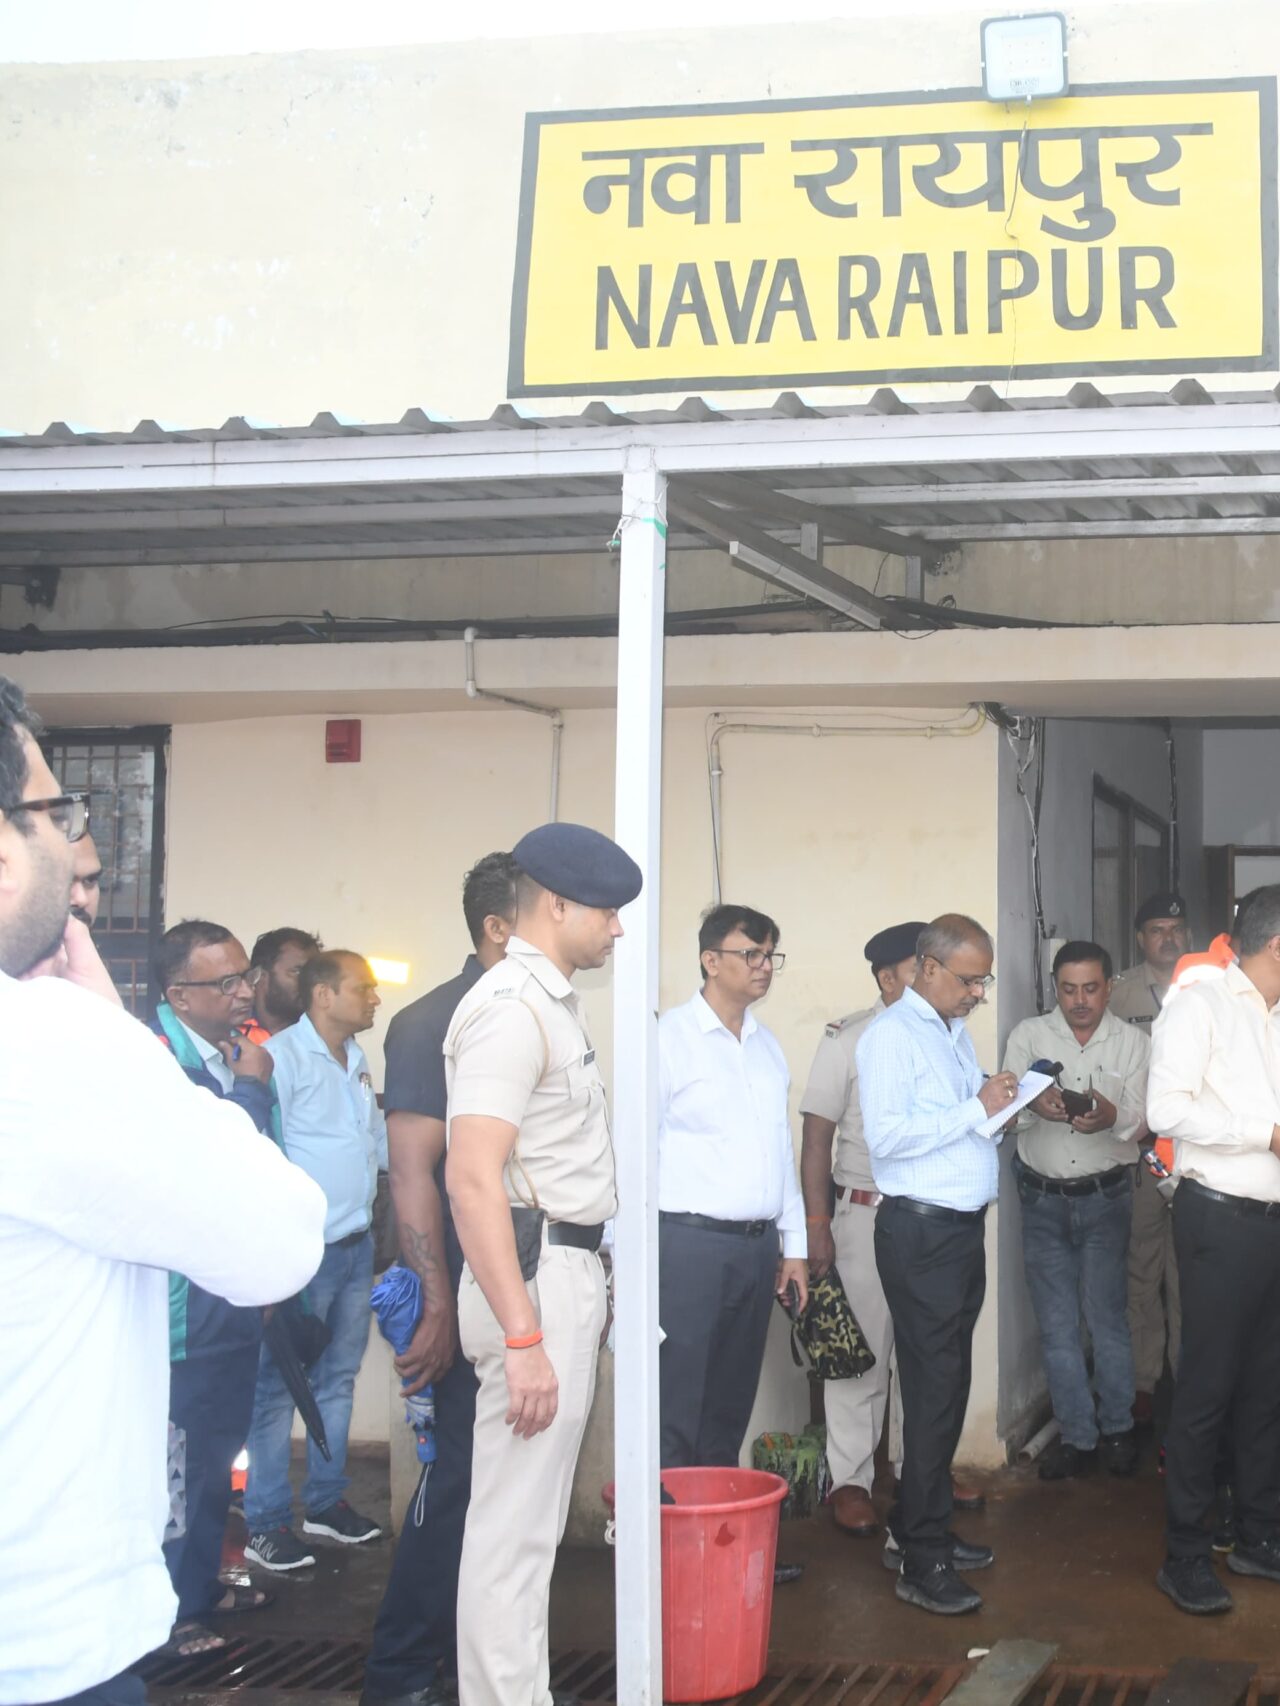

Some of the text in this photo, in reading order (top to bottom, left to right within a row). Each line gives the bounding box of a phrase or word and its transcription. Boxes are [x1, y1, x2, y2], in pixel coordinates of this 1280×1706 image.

[582, 122, 1213, 242] नवा रायपुर
[595, 246, 1177, 351] NAVA RAIPUR
